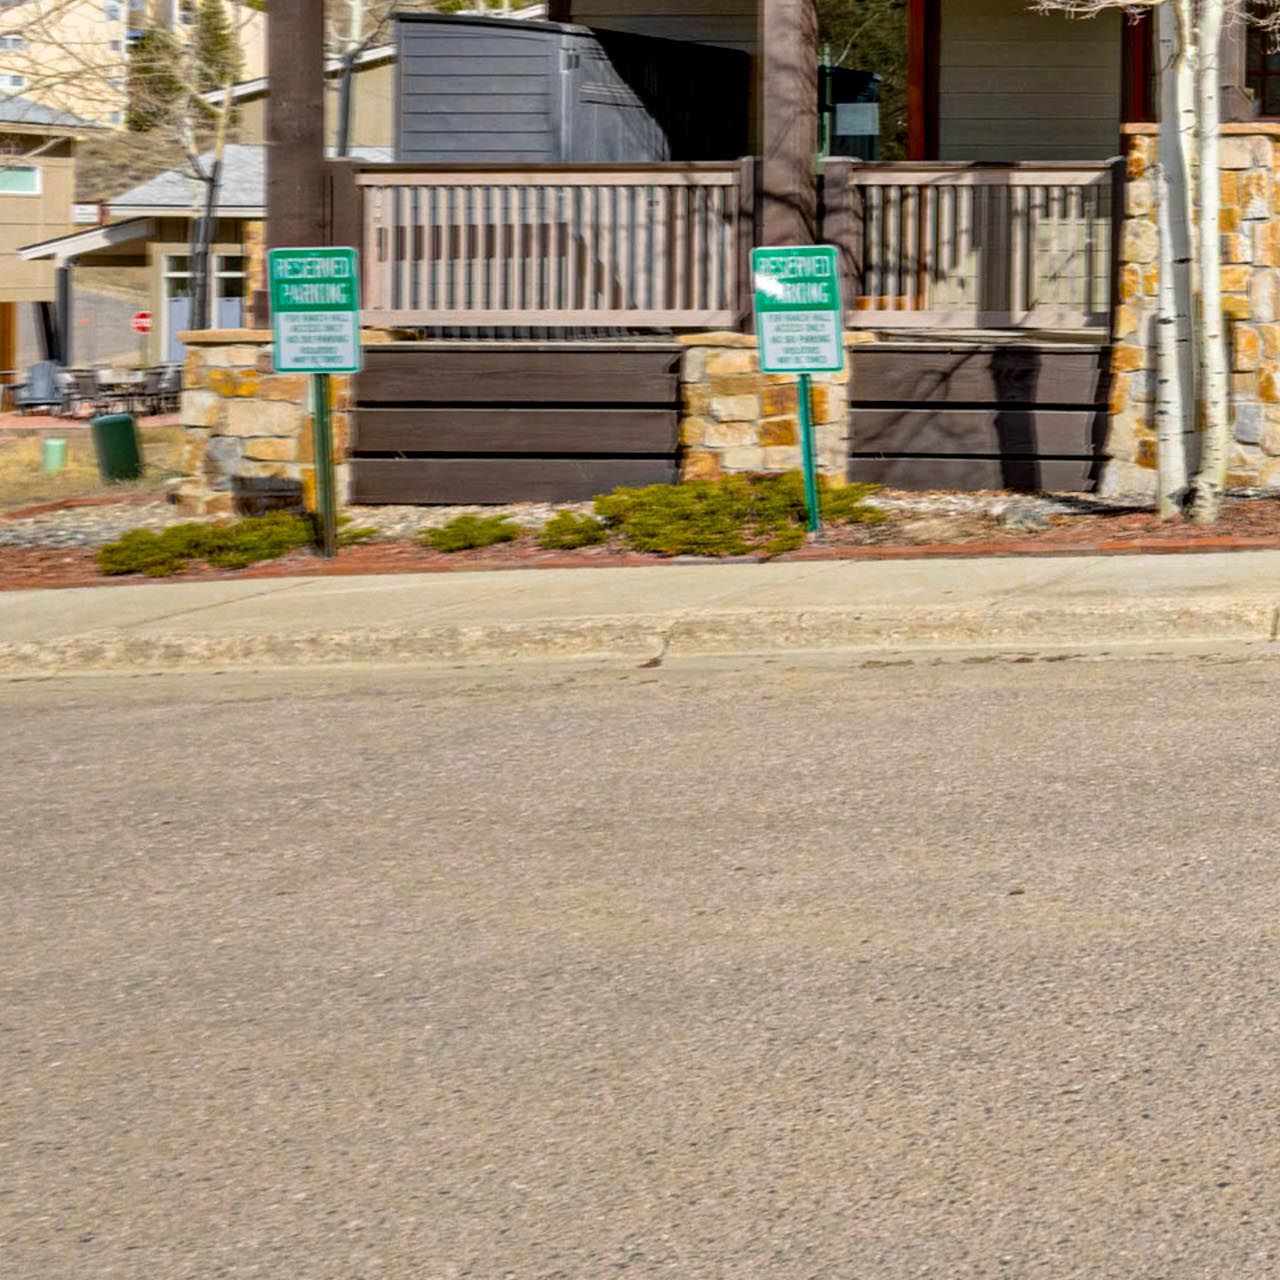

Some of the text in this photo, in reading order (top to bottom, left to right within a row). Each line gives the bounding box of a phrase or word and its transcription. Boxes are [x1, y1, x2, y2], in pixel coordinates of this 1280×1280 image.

[274, 257, 350, 278] RESERVED
[757, 256, 831, 277] RESERVED
[282, 283, 348, 304] PARKING
[764, 283, 829, 303] RKING
